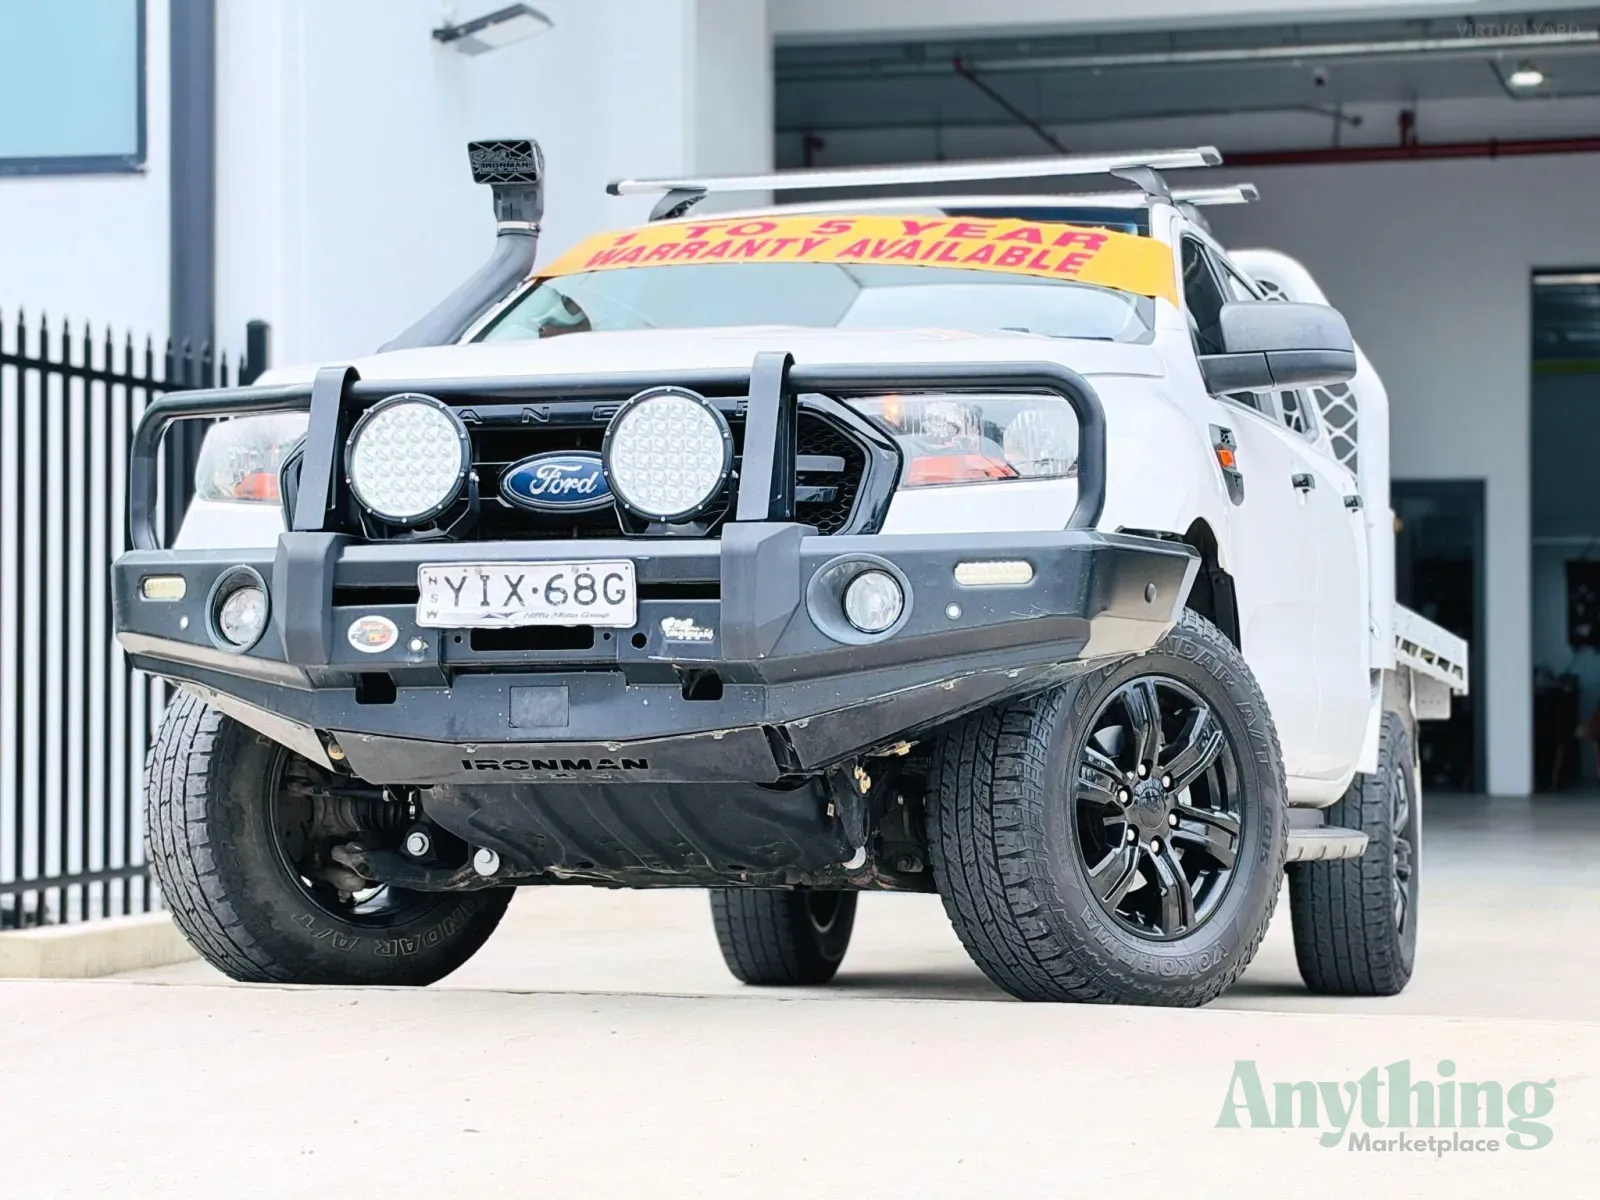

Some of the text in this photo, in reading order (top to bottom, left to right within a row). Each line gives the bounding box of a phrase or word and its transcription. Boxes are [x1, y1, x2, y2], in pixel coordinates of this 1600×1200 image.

[613, 220, 1109, 250] 1 TO 5 YEAR
[584, 238, 1095, 274] WARRANTY AVAILABLE
[529, 464, 598, 495] Ford
[461, 758, 649, 770] IRONMAN
[1080, 904, 1229, 977] YOKOHAMA
